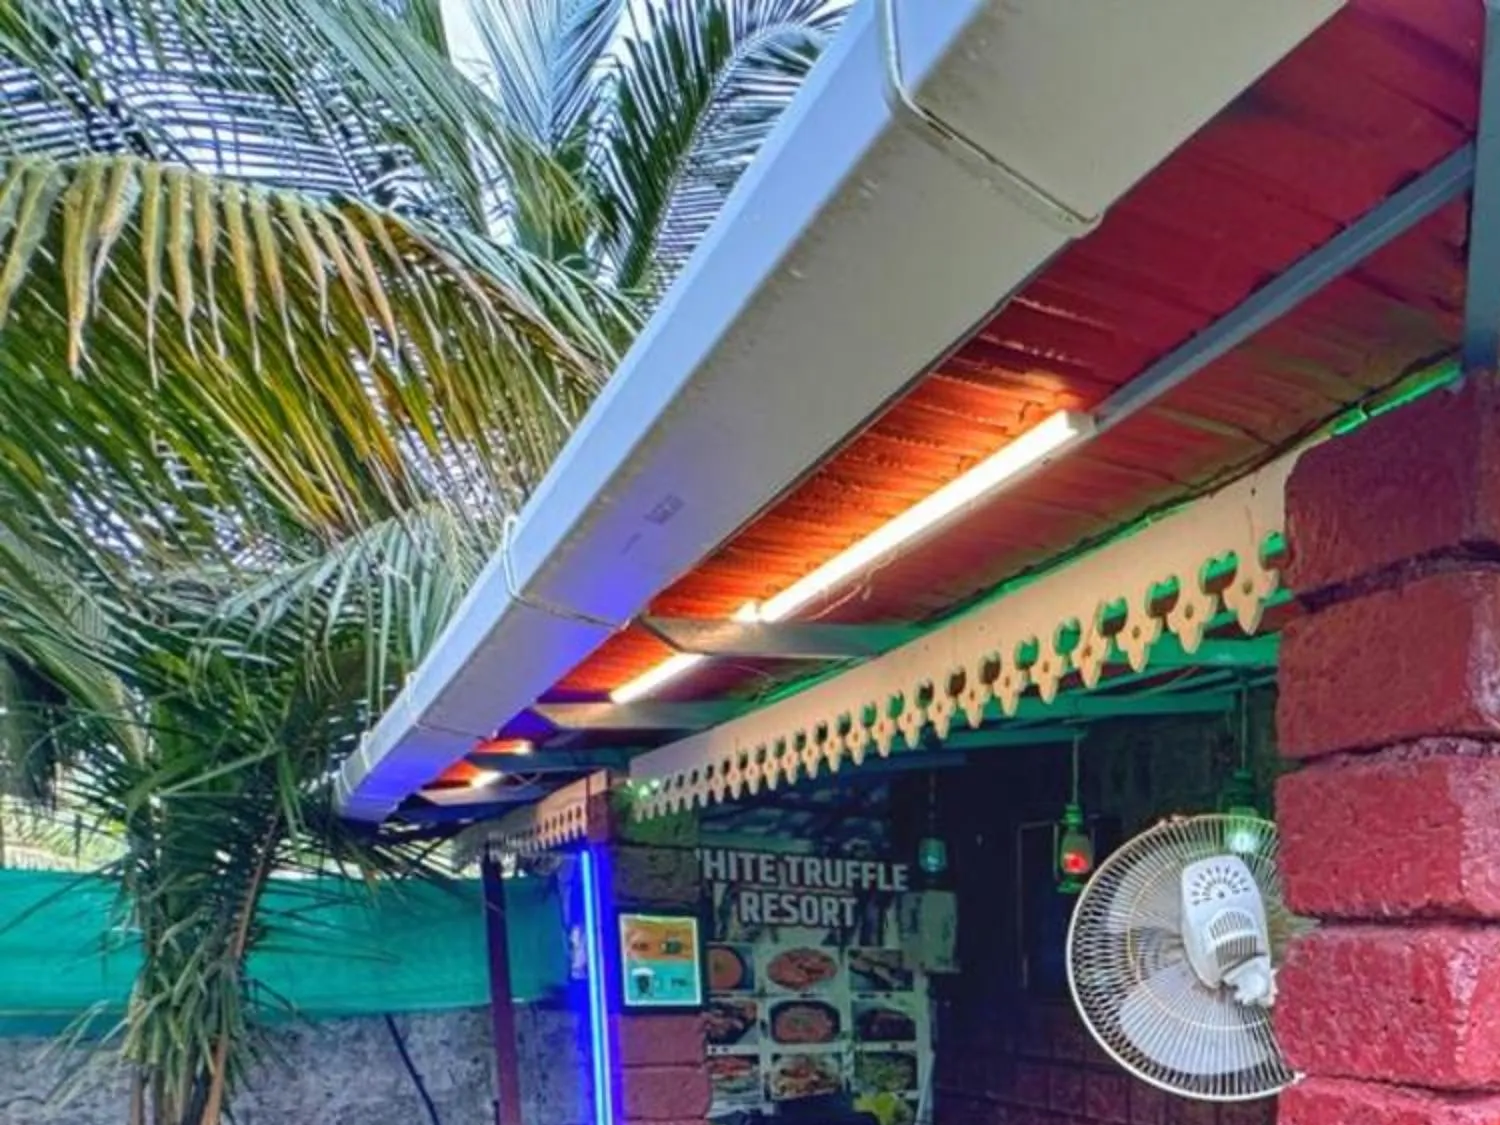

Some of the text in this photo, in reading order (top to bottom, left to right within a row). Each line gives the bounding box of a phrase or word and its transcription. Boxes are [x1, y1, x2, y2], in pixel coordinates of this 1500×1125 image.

[696, 848, 908, 892] HITE TRUFFLE
[740, 892, 858, 928] RESORT
